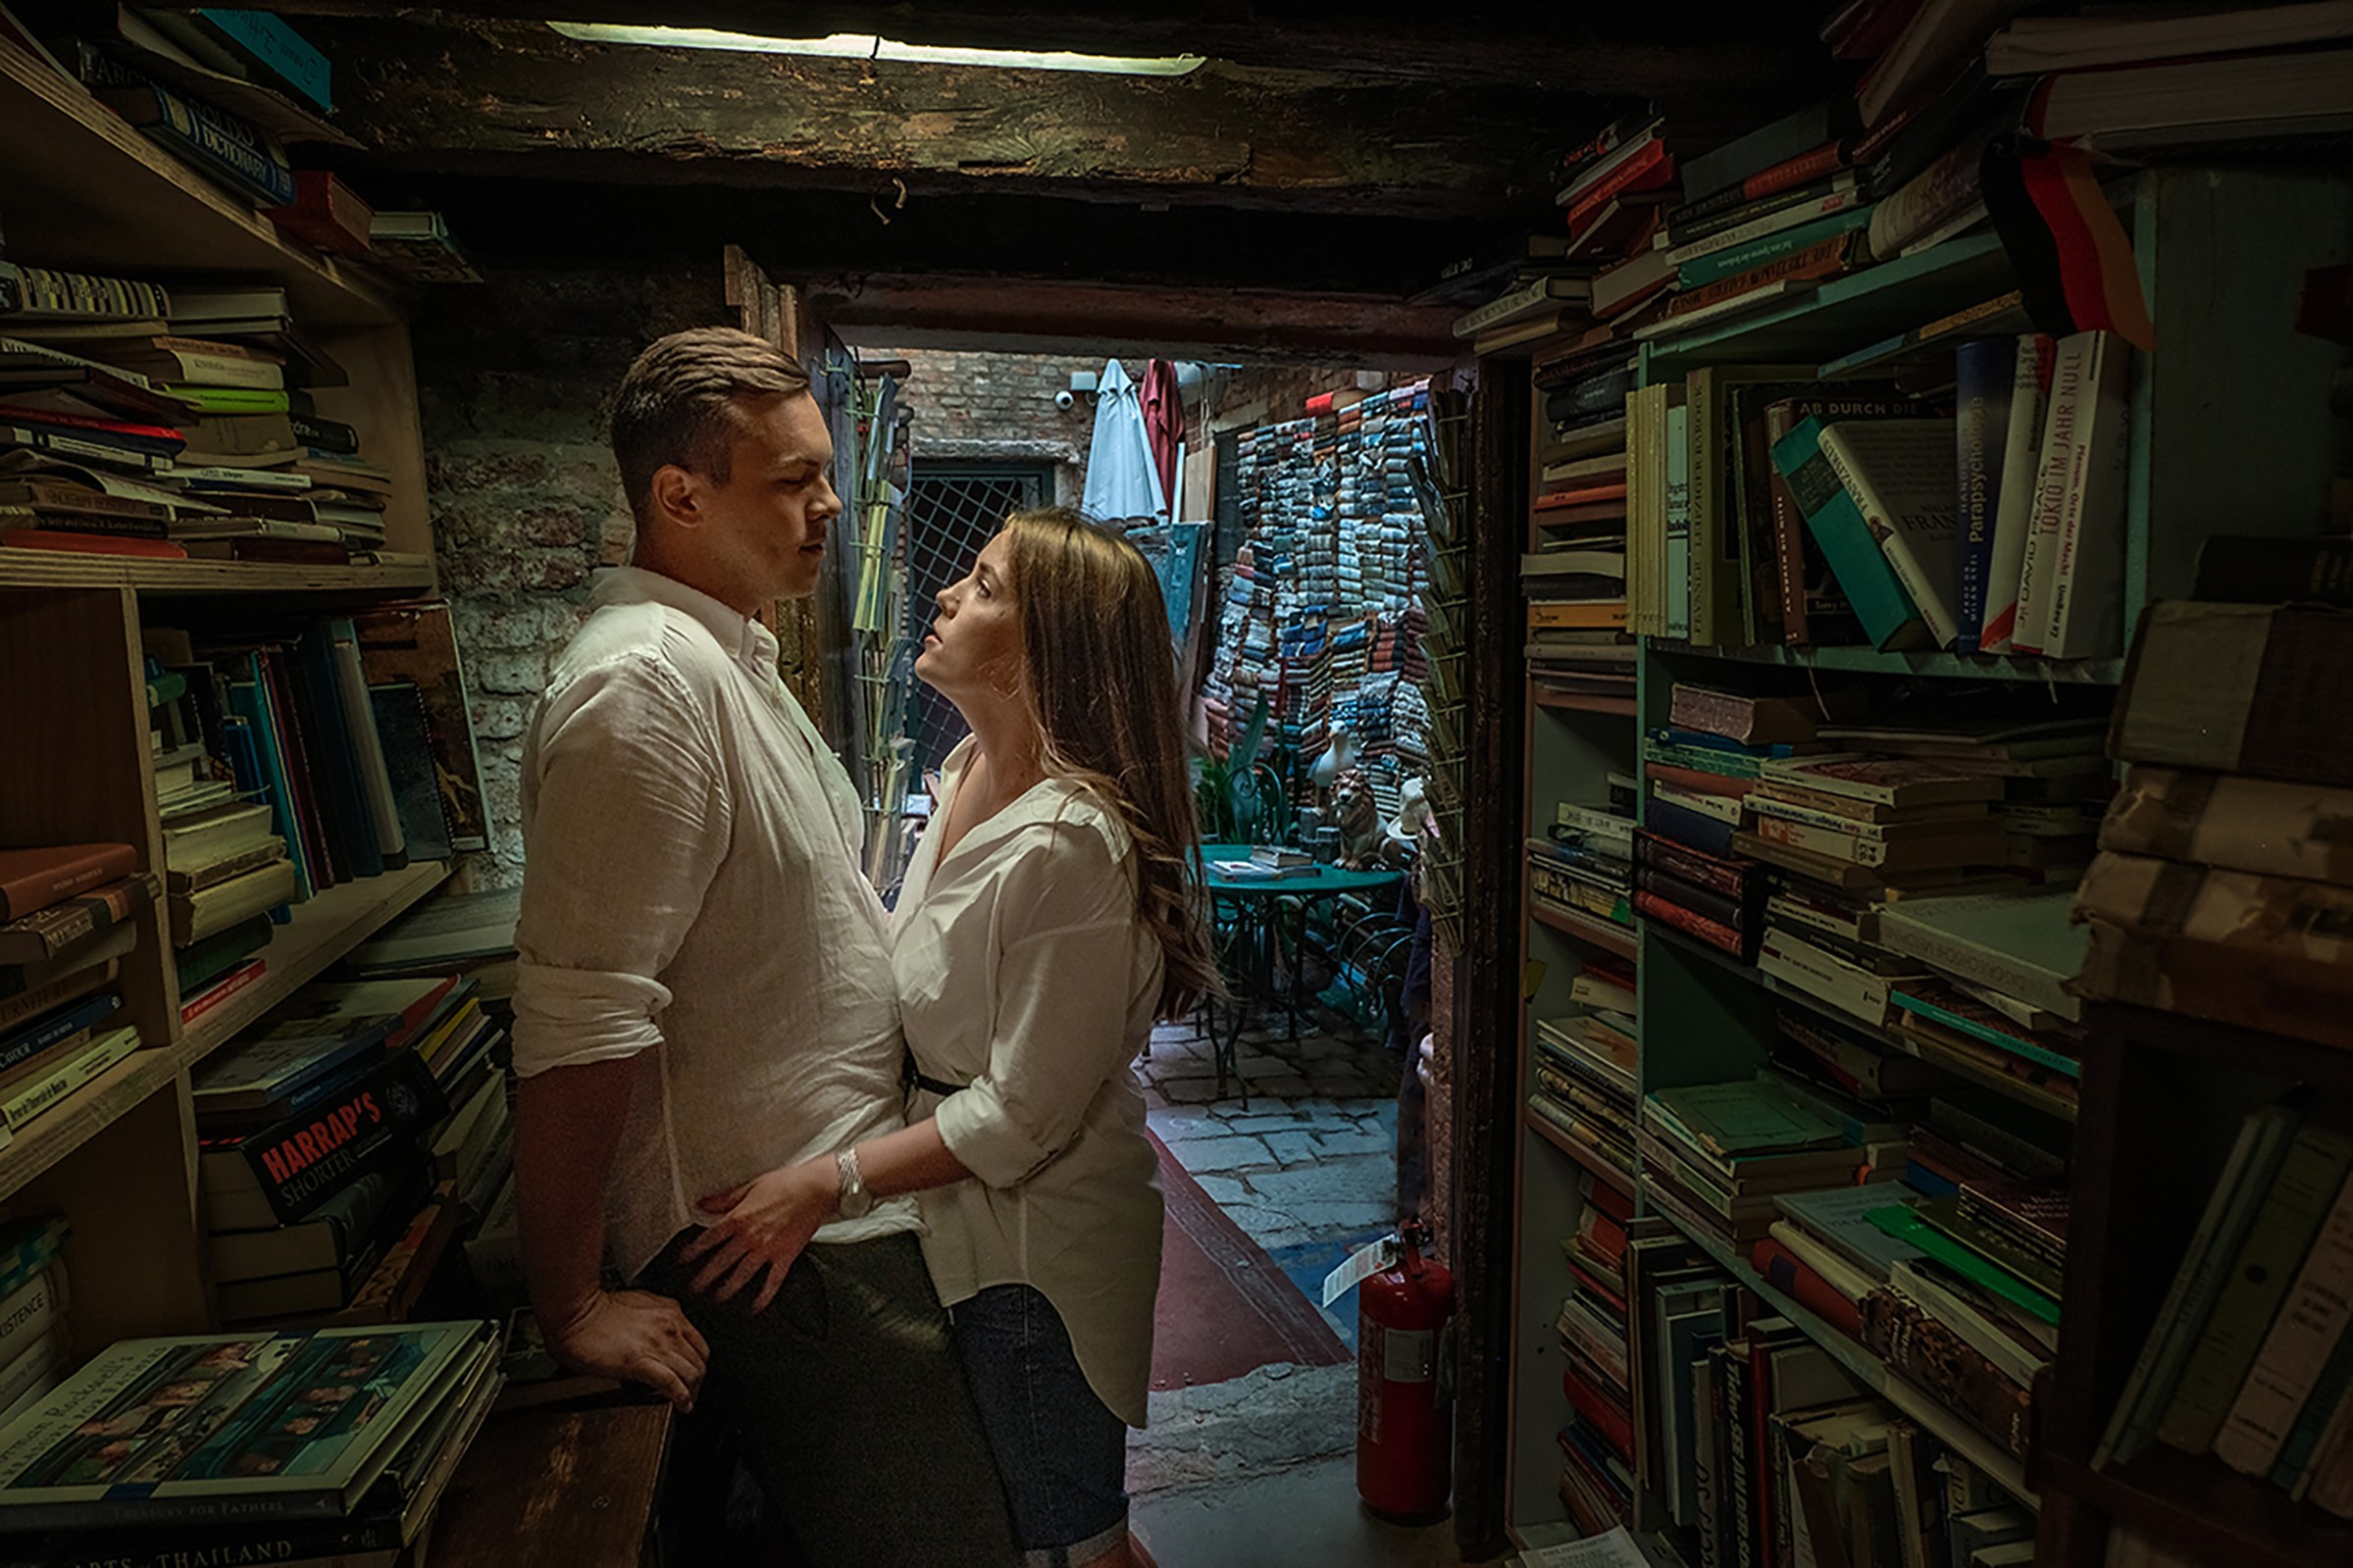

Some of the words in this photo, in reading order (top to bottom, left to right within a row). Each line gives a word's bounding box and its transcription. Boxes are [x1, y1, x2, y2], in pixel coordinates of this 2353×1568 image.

[2059, 350, 2083, 396] NULL
[1799, 402, 1824, 416] AB
[1828, 402, 1886, 416] DURCH
[2051, 402, 2075, 450] JAHR
[1965, 394, 1988, 543] Parapsychologie
[2048, 455, 2068, 478] IM
[2039, 482, 2065, 536] TOKIO
[260, 1089, 384, 1186] HARRAP'S
[280, 1148, 358, 1209] SHORTER
[154, 1539, 294, 1568] THAILAND
